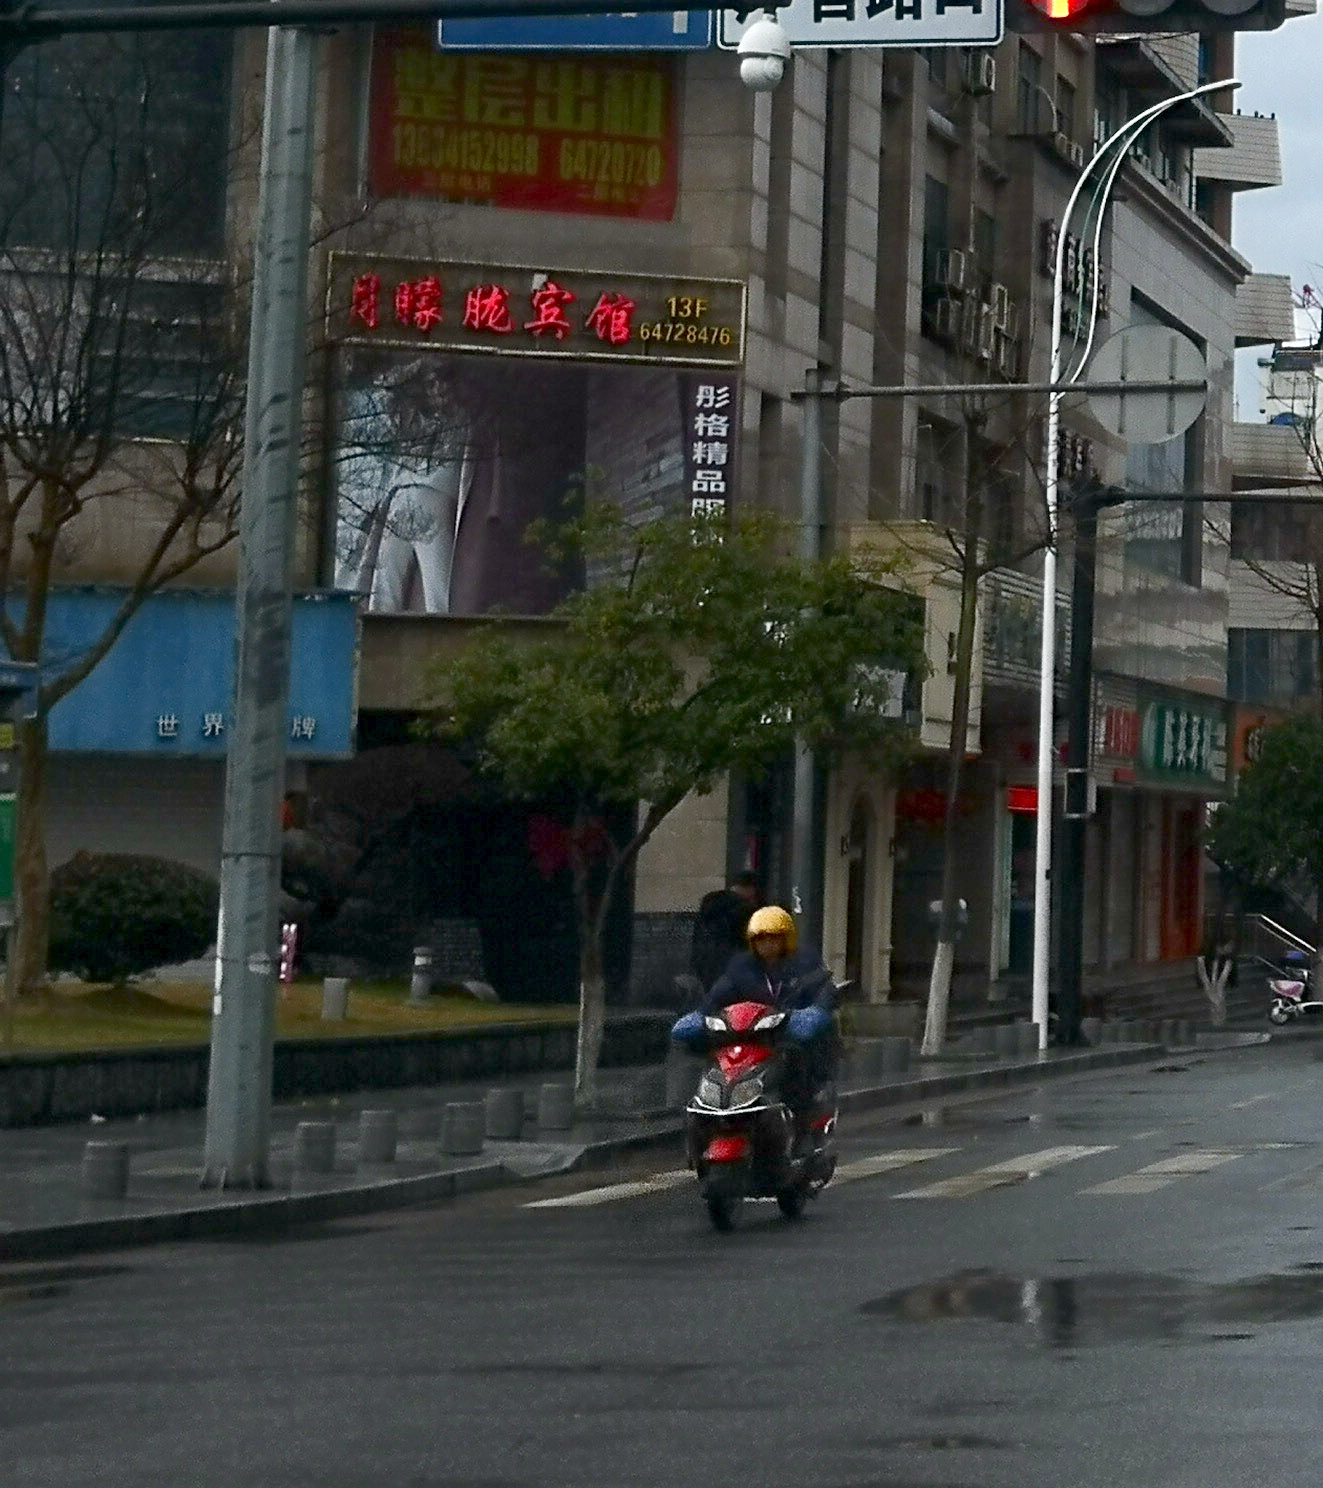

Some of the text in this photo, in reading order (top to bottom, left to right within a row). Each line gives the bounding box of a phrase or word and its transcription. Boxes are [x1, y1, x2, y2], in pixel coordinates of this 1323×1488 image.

[666, 297, 708, 319] 13F
[639, 322, 732, 346] 64728476
[157, 711, 317, 739] 世界牌
